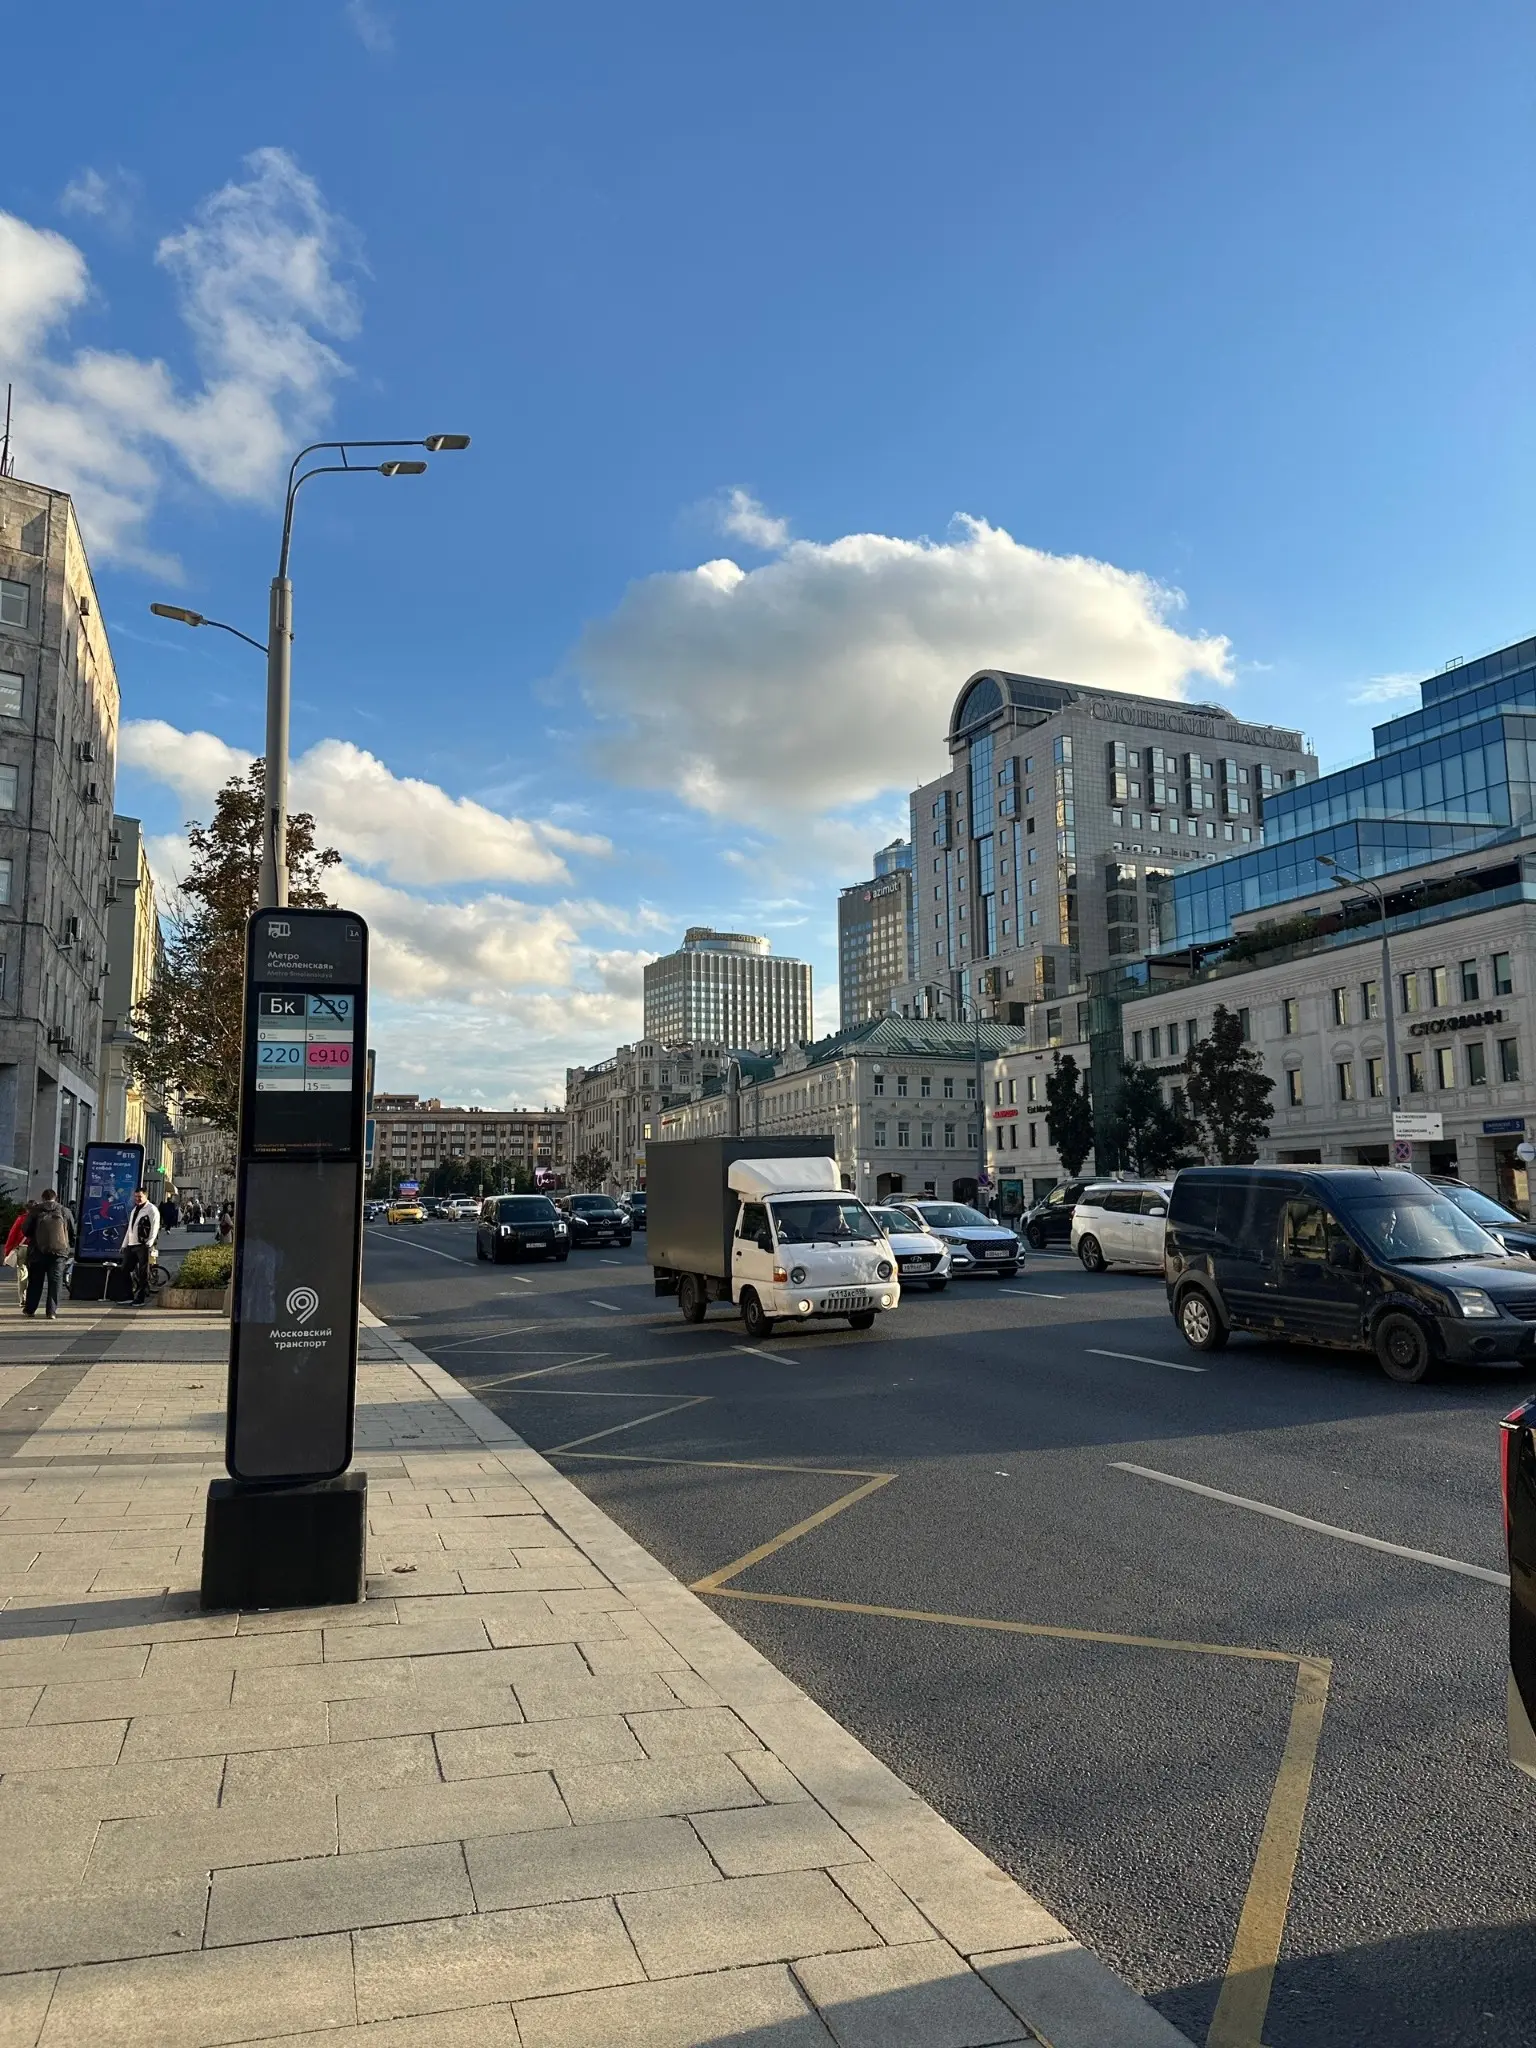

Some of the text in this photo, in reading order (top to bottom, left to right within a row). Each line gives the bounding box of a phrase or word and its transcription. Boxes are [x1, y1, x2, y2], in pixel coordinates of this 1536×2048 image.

[1092, 702, 1300, 749] СМОЛЕНСКИЙ ПАССАЖ
[872, 881, 898, 899] azimut
[267, 951, 300, 961] Метро
[267, 960, 334, 970] «Смоленская»
[270, 998, 296, 1014] Бк
[312, 999, 349, 1015] 239
[308, 1033, 314, 1041] 5
[262, 1047, 300, 1063] 220
[257, 1082, 264, 1090] 6
[307, 1083, 319, 1091] 15
[269, 1327, 332, 1338] Московский
[274, 1340, 327, 1350] транспорт
